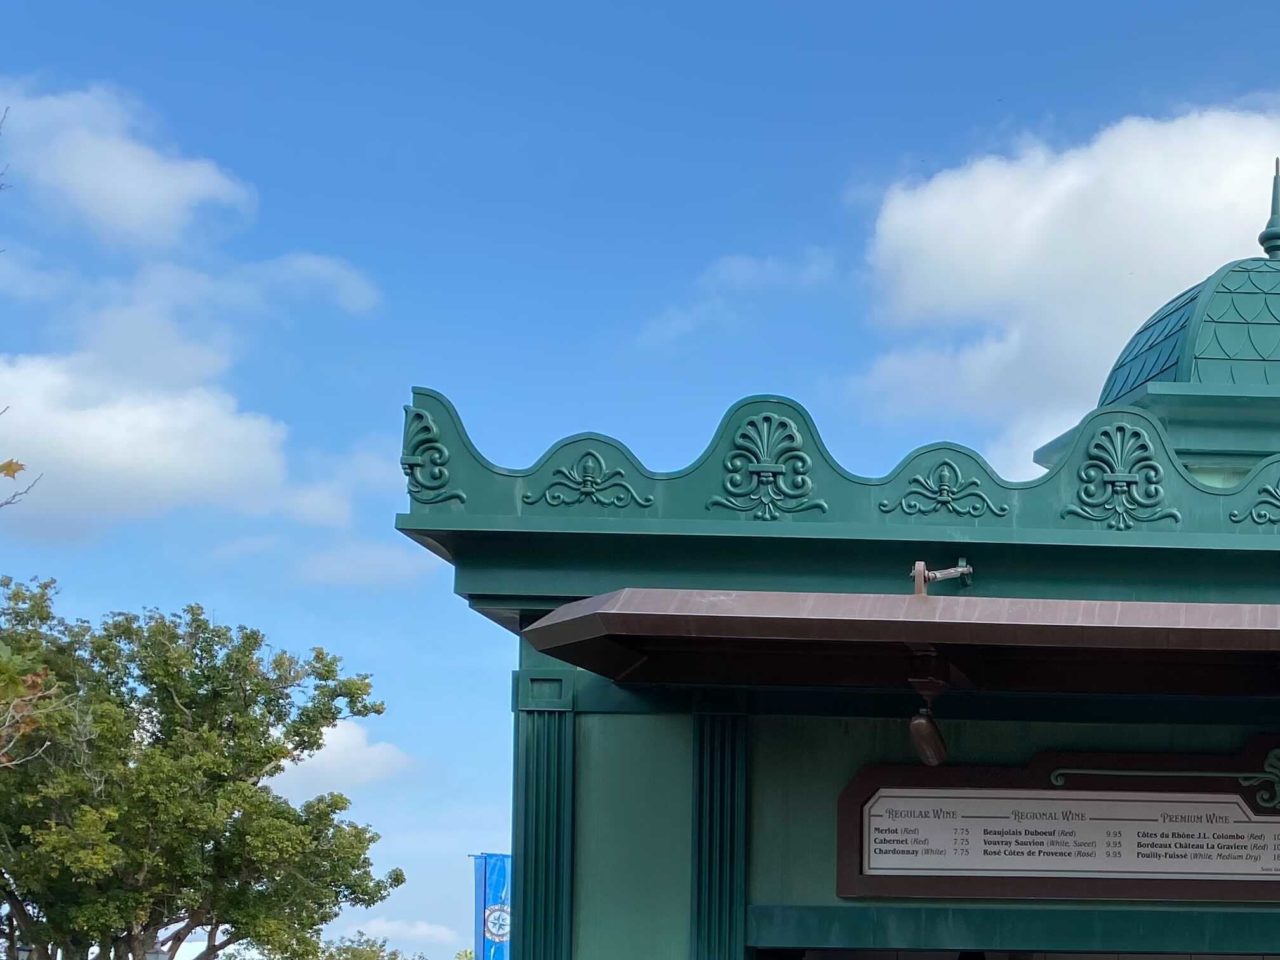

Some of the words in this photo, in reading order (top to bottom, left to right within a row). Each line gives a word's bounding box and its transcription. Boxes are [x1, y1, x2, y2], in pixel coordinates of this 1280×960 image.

[885, 808, 931, 820] REGULAR
[932, 808, 958, 819] WINE
[1011, 810, 1058, 822] REGIONAL
[1060, 811, 1087, 822] WINE
[1160, 813, 1204, 824] PREMIUM
[1206, 813, 1230, 824] WINE
[983, 829, 1022, 838] Beaujolais
[1171, 831, 1194, 839] Rhône
[1212, 832, 1245, 840] Colombo
[1247, 832, 1266, 842] (Red)
[983, 839, 1012, 848] Vouvray
[1250, 843, 1268, 851] (Red)
[874, 848, 919, 857] Chardonnay
[1004, 848, 1025, 857] Côtes
[1038, 850, 1072, 858] Provence
